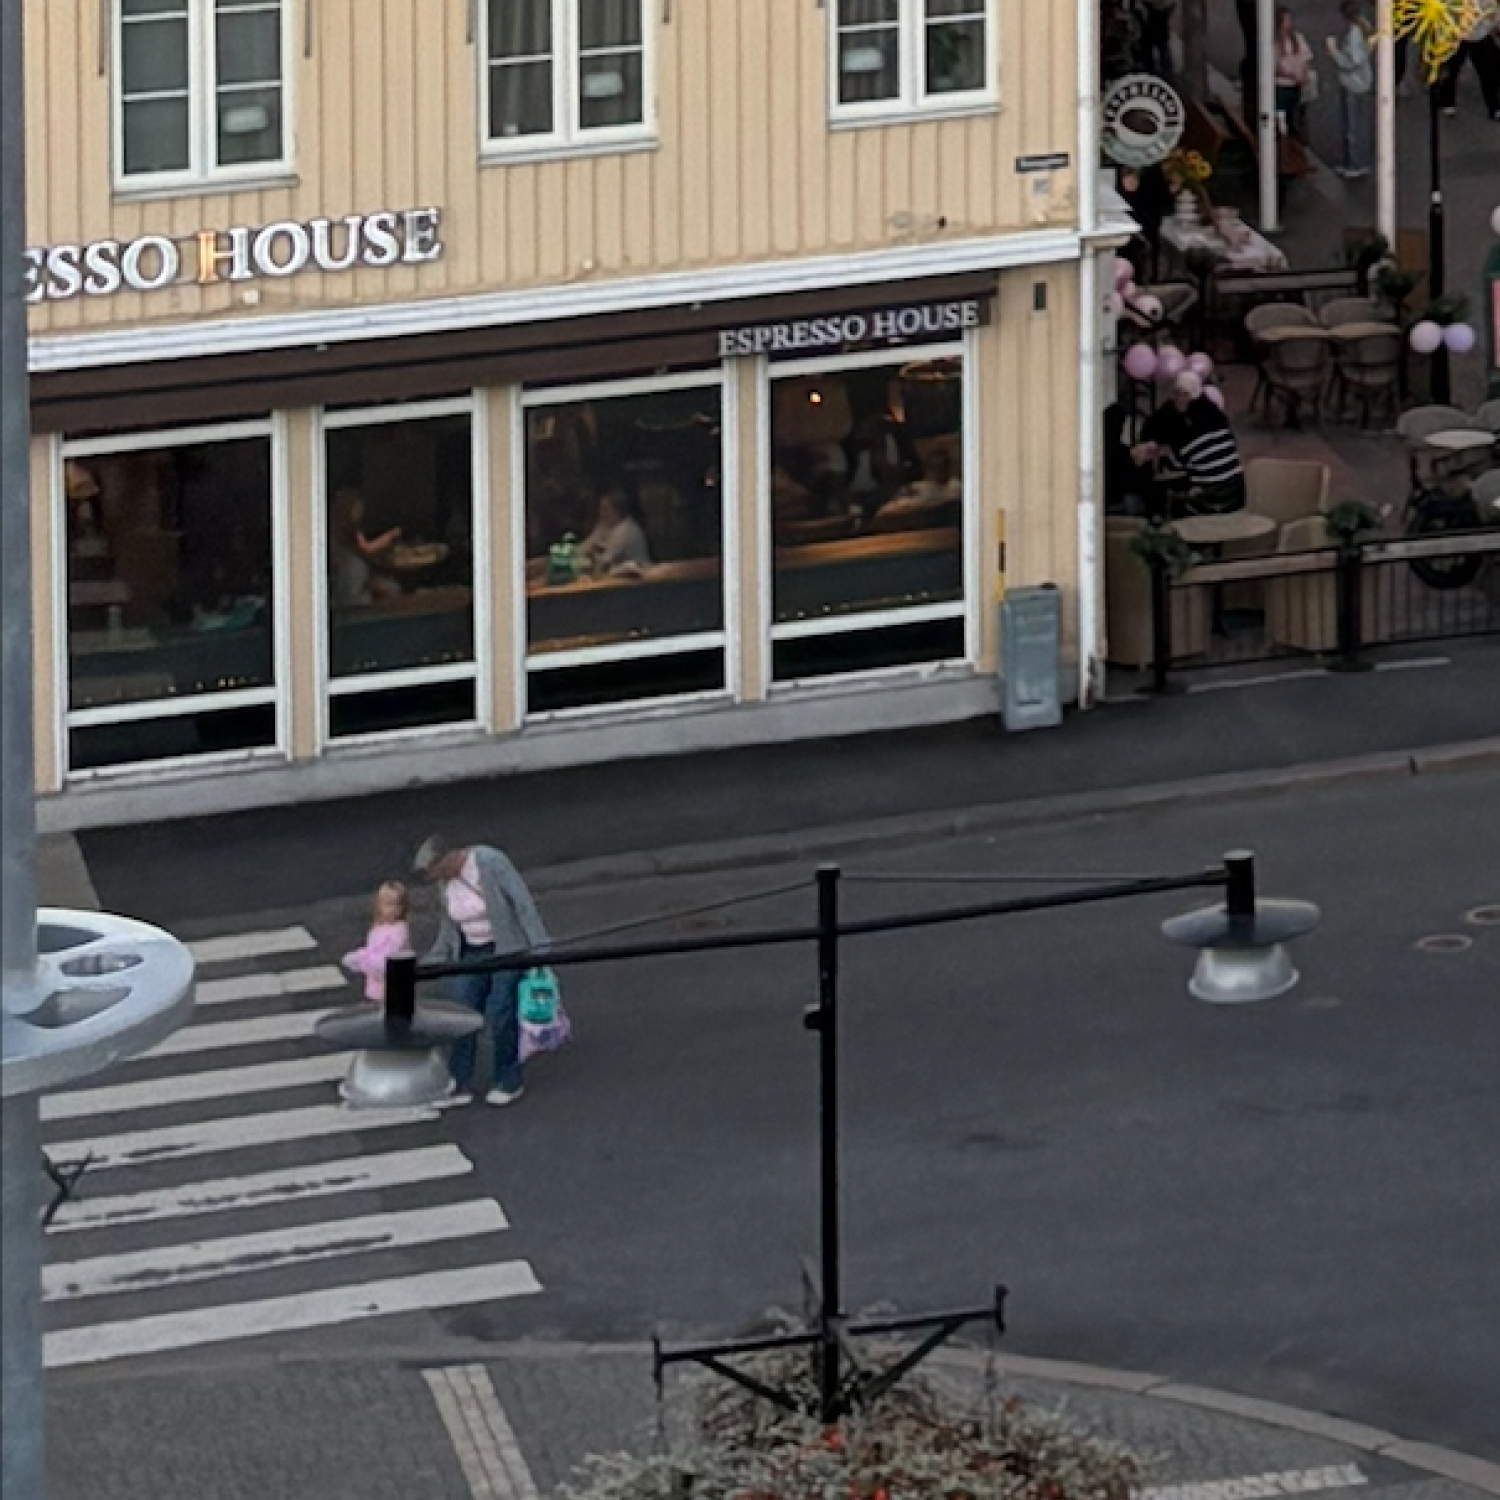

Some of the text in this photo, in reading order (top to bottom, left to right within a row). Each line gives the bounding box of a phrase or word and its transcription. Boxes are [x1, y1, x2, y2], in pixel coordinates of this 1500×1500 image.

[198, 207, 442, 284] HOUSE
[719, 300, 979, 355] ESPRESSO HOUSE
